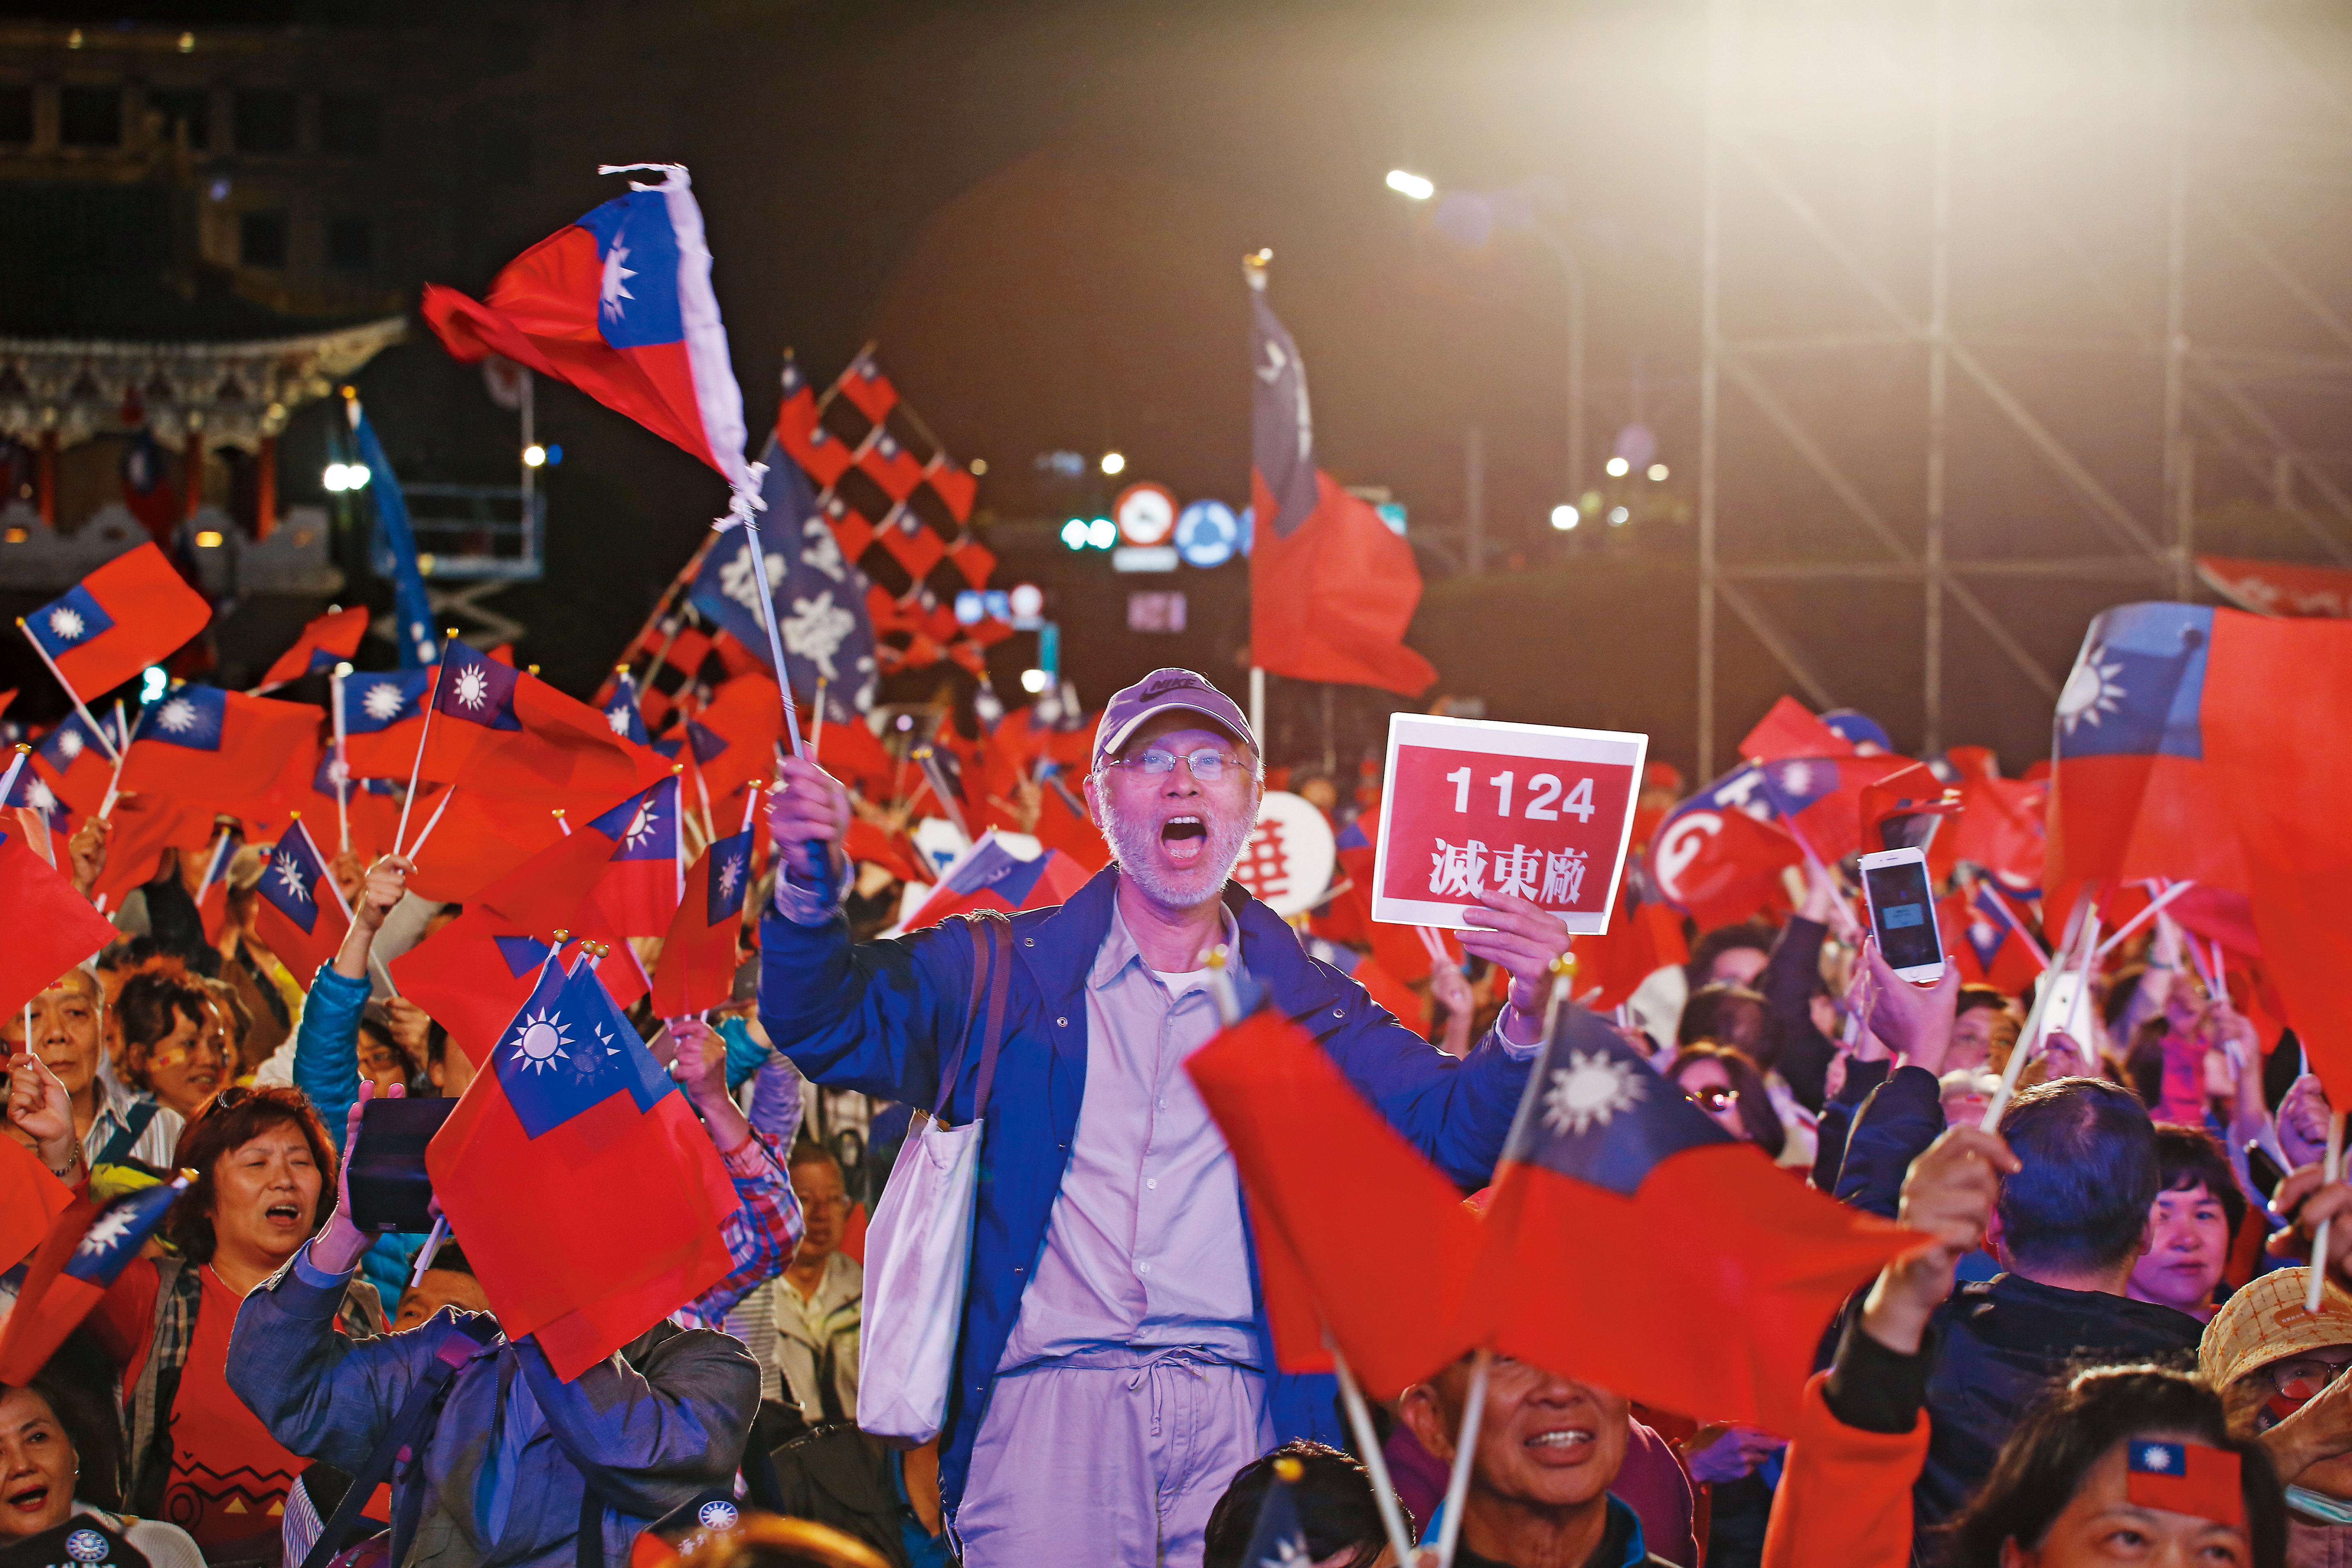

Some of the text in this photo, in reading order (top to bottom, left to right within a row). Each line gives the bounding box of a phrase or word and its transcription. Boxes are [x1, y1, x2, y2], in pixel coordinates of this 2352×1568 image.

[1150, 678, 1196, 691] NIKE
[1446, 766, 1596, 824] 1124
[1429, 837, 1589, 904] 滅東廠
